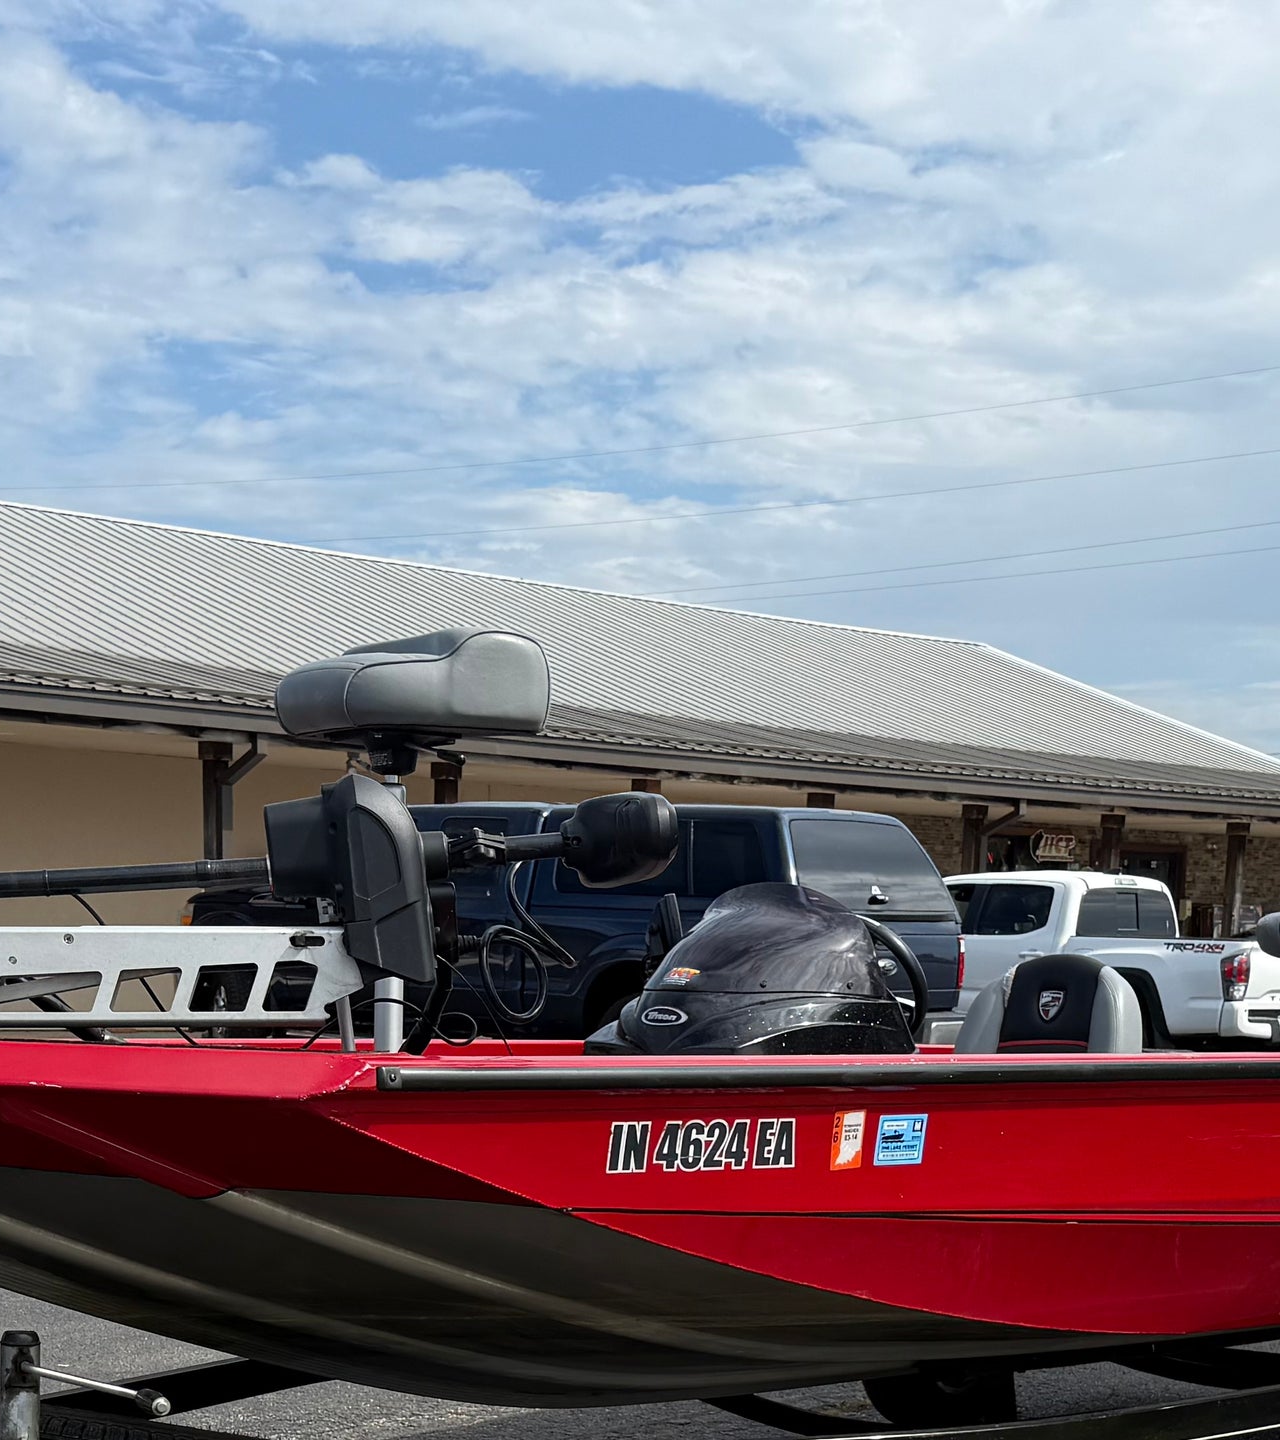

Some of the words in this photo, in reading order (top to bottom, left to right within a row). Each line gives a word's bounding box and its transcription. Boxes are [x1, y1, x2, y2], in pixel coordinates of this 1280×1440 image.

[607, 1122, 651, 1173] IN
[653, 1119, 751, 1172] 4624
[752, 1118, 796, 1169] EA
